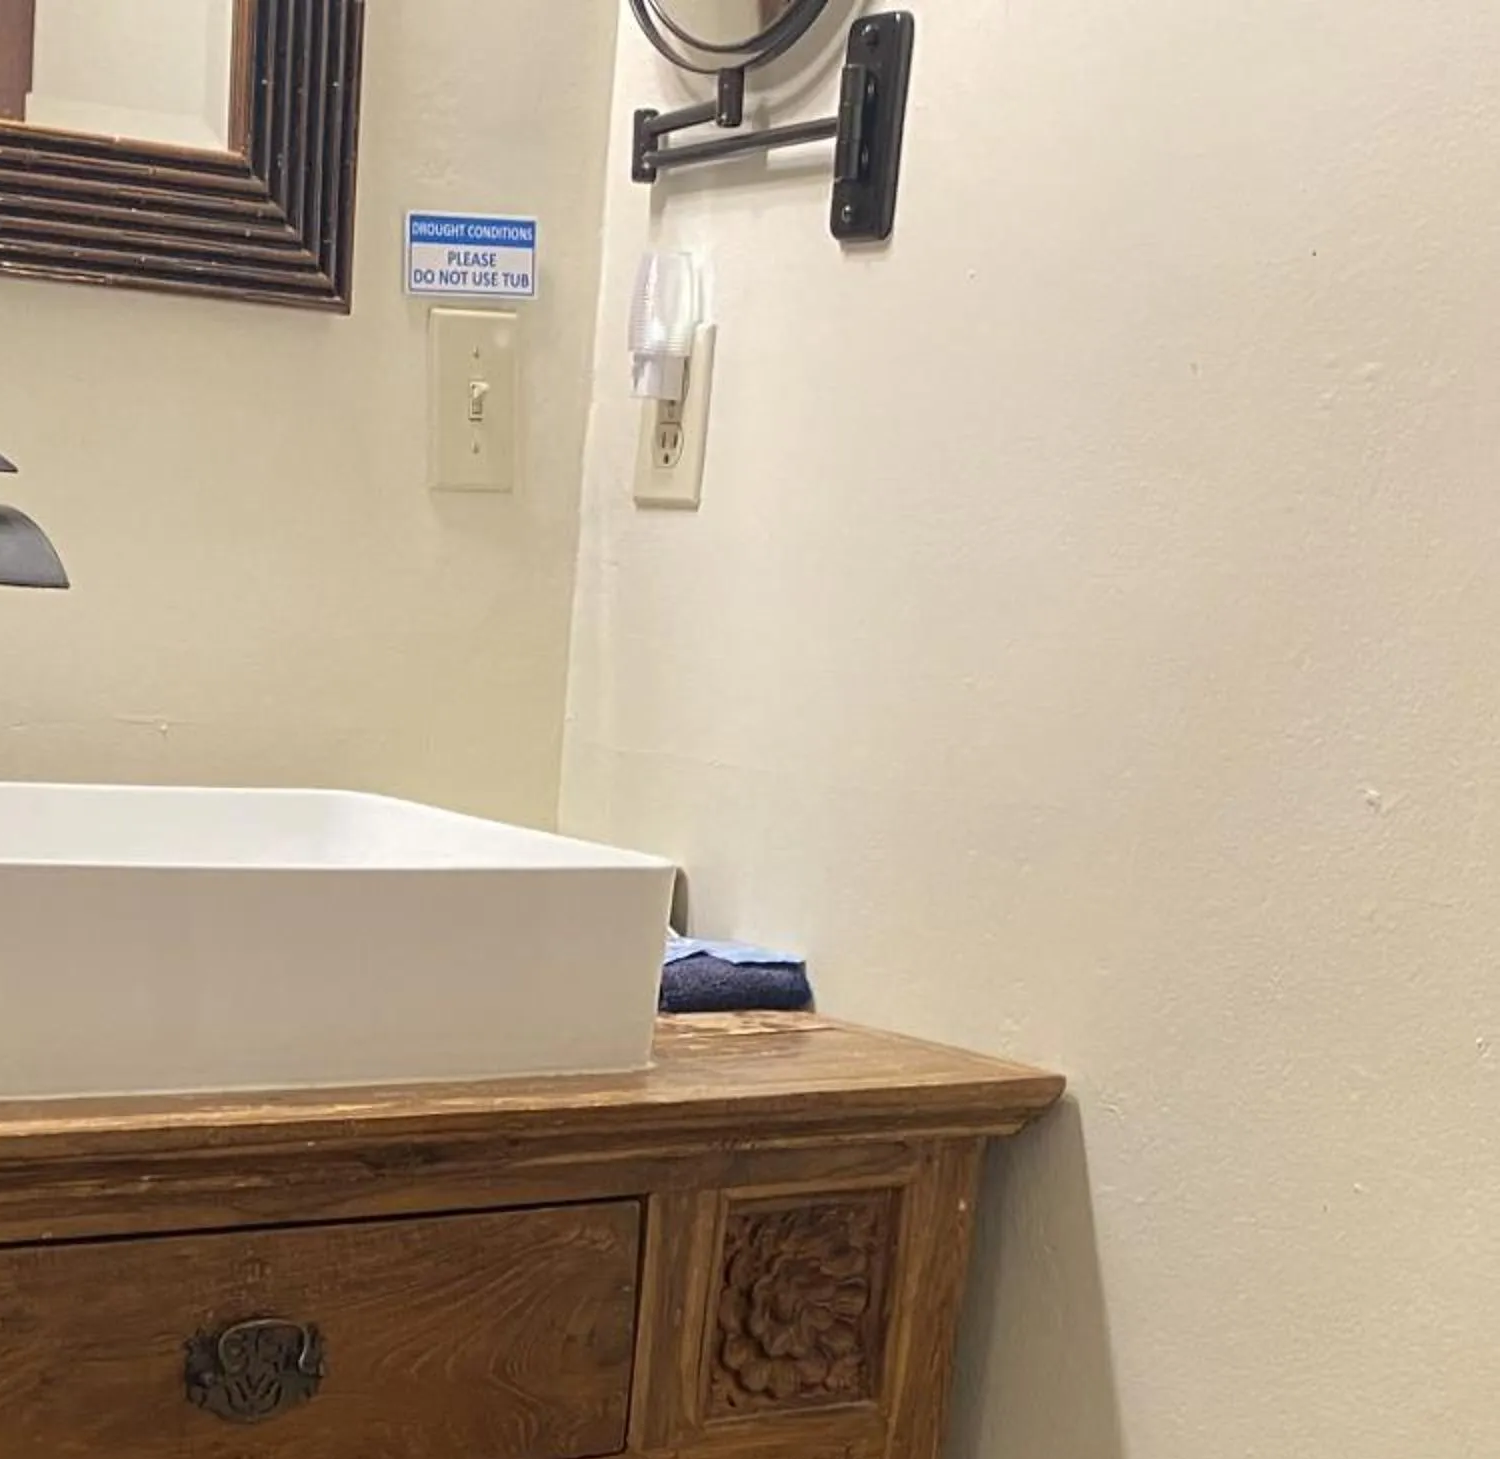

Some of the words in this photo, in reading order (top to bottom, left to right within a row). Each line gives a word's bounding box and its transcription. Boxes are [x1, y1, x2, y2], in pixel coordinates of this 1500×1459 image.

[411, 222, 465, 238] DROUGHT
[467, 224, 533, 241] CONDITIONS
[447, 250, 497, 268] PLEASE
[413, 268, 435, 284] DO
[439, 269, 468, 285] NOT
[472, 271, 498, 287] USE
[502, 273, 529, 288] TUB
